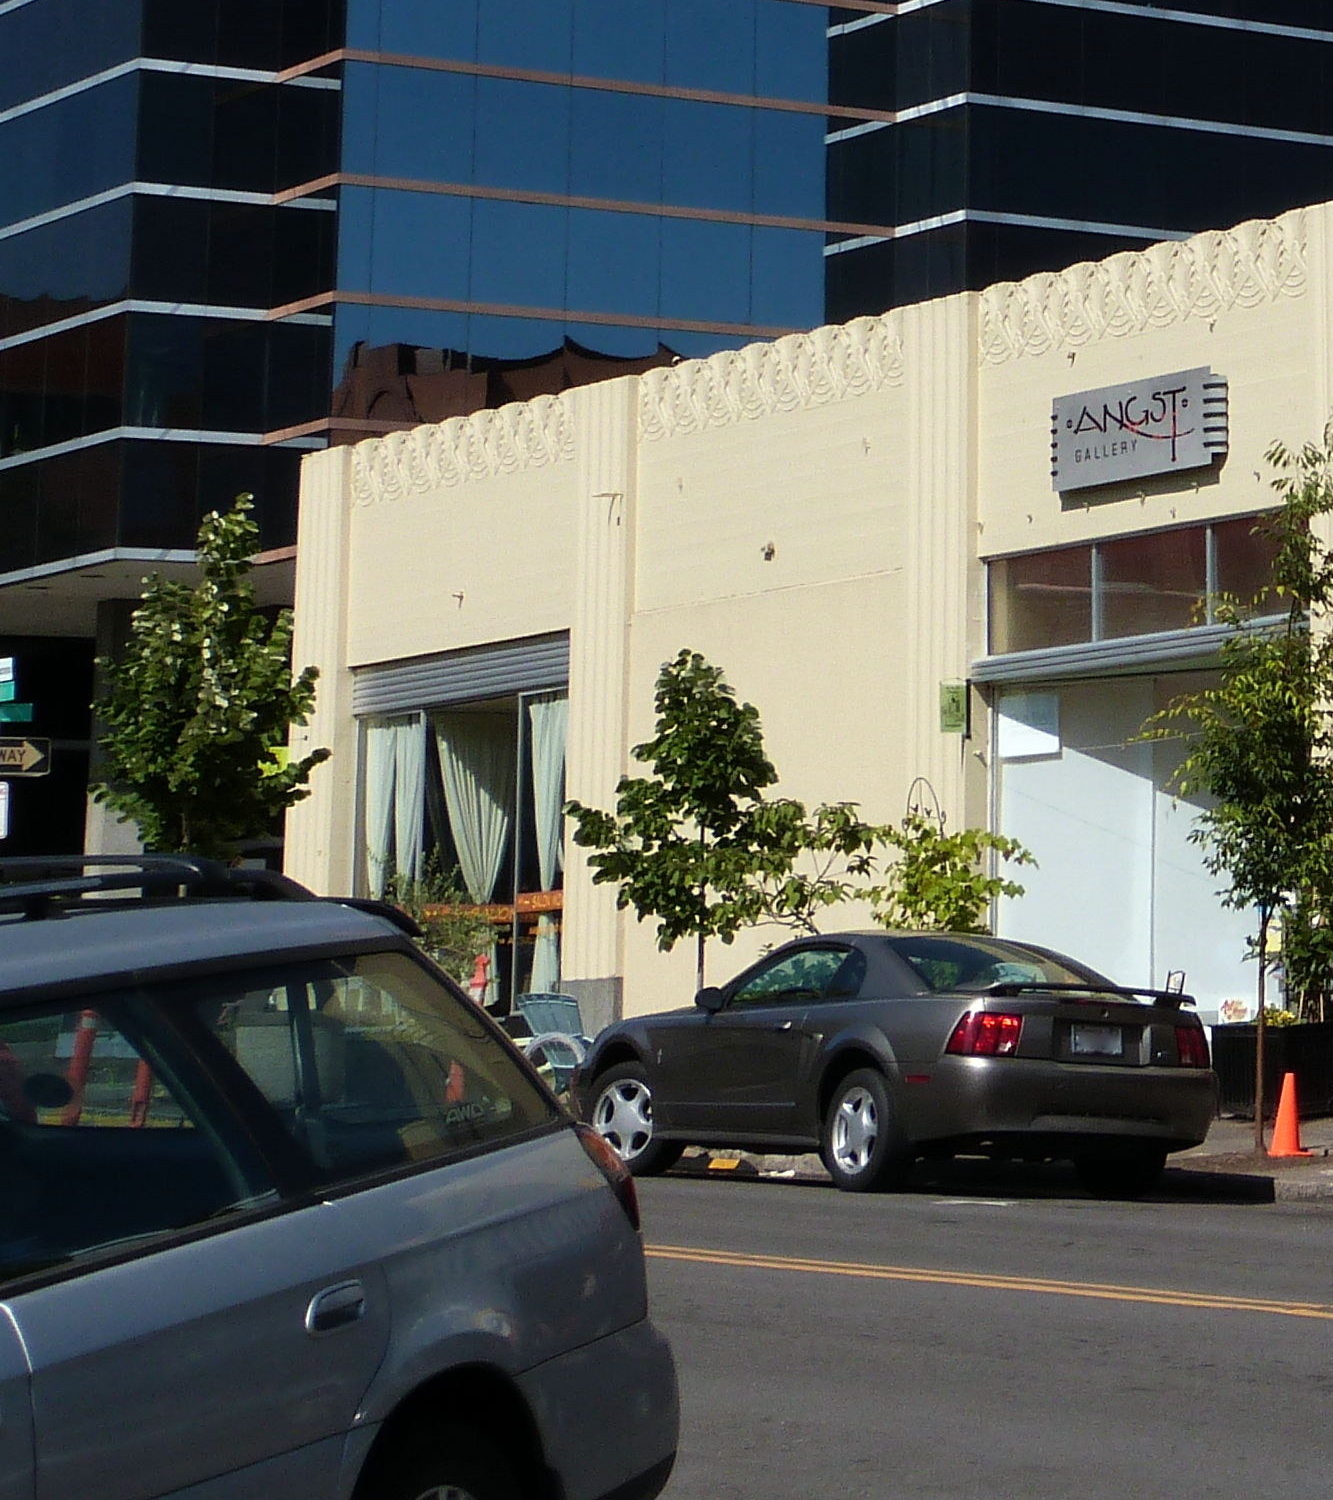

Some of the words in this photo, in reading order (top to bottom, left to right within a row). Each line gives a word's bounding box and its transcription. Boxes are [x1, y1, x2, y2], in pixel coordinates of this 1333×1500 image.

[1074, 386, 1187, 462] ANGST
[1074, 438, 1138, 464] GALLERY
[446, 1104, 484, 1125] AWD
